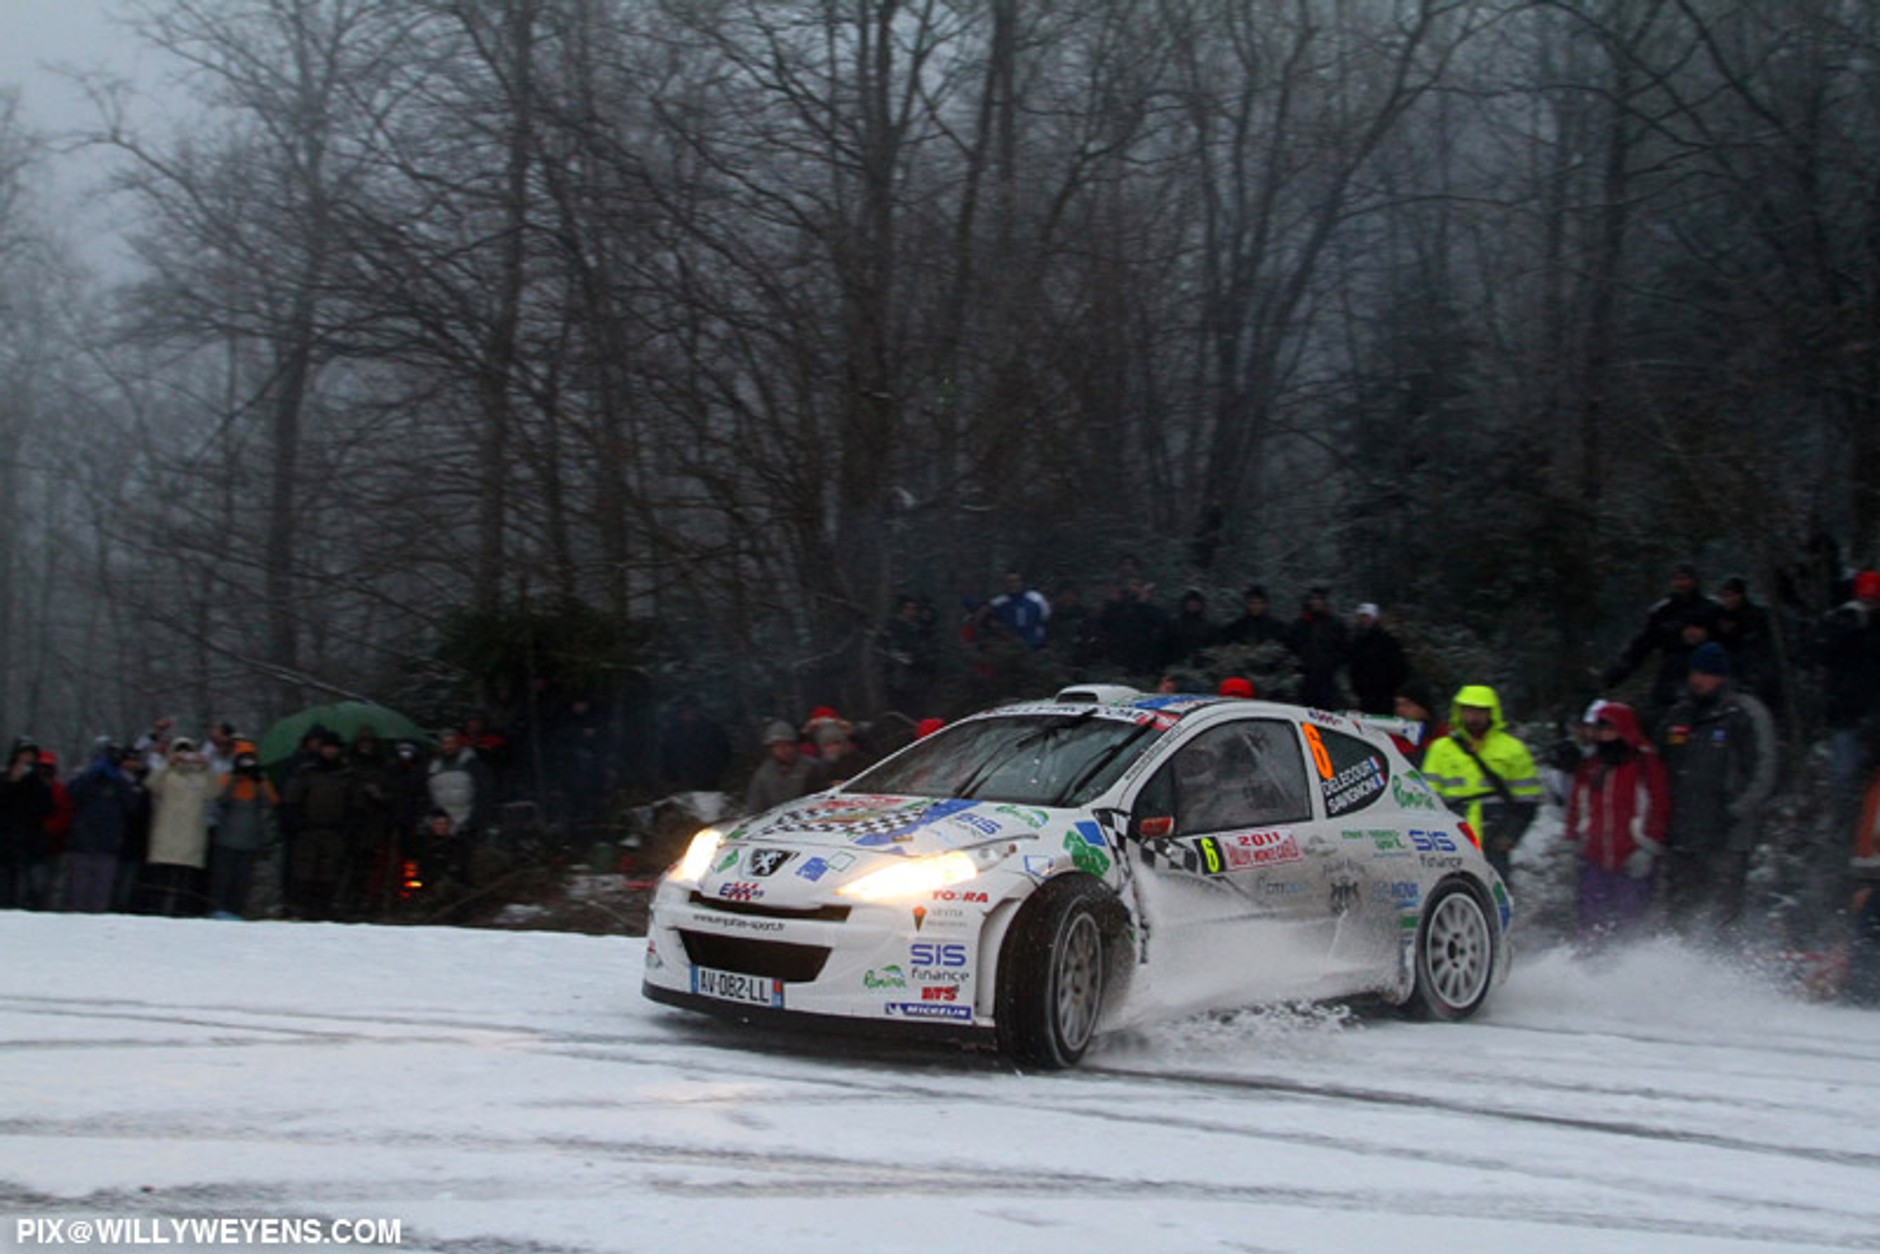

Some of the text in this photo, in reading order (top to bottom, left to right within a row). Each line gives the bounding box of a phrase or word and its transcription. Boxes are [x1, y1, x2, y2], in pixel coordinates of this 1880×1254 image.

[1301, 722, 1334, 781] 6
[1237, 831, 1281, 847] 2011
[1408, 829, 1457, 852] SIS
[1201, 837, 1220, 873] 6
[910, 944, 966, 967] SIS
[911, 966, 970, 982] finance
[906, 1005, 968, 1017] MICHELIN
